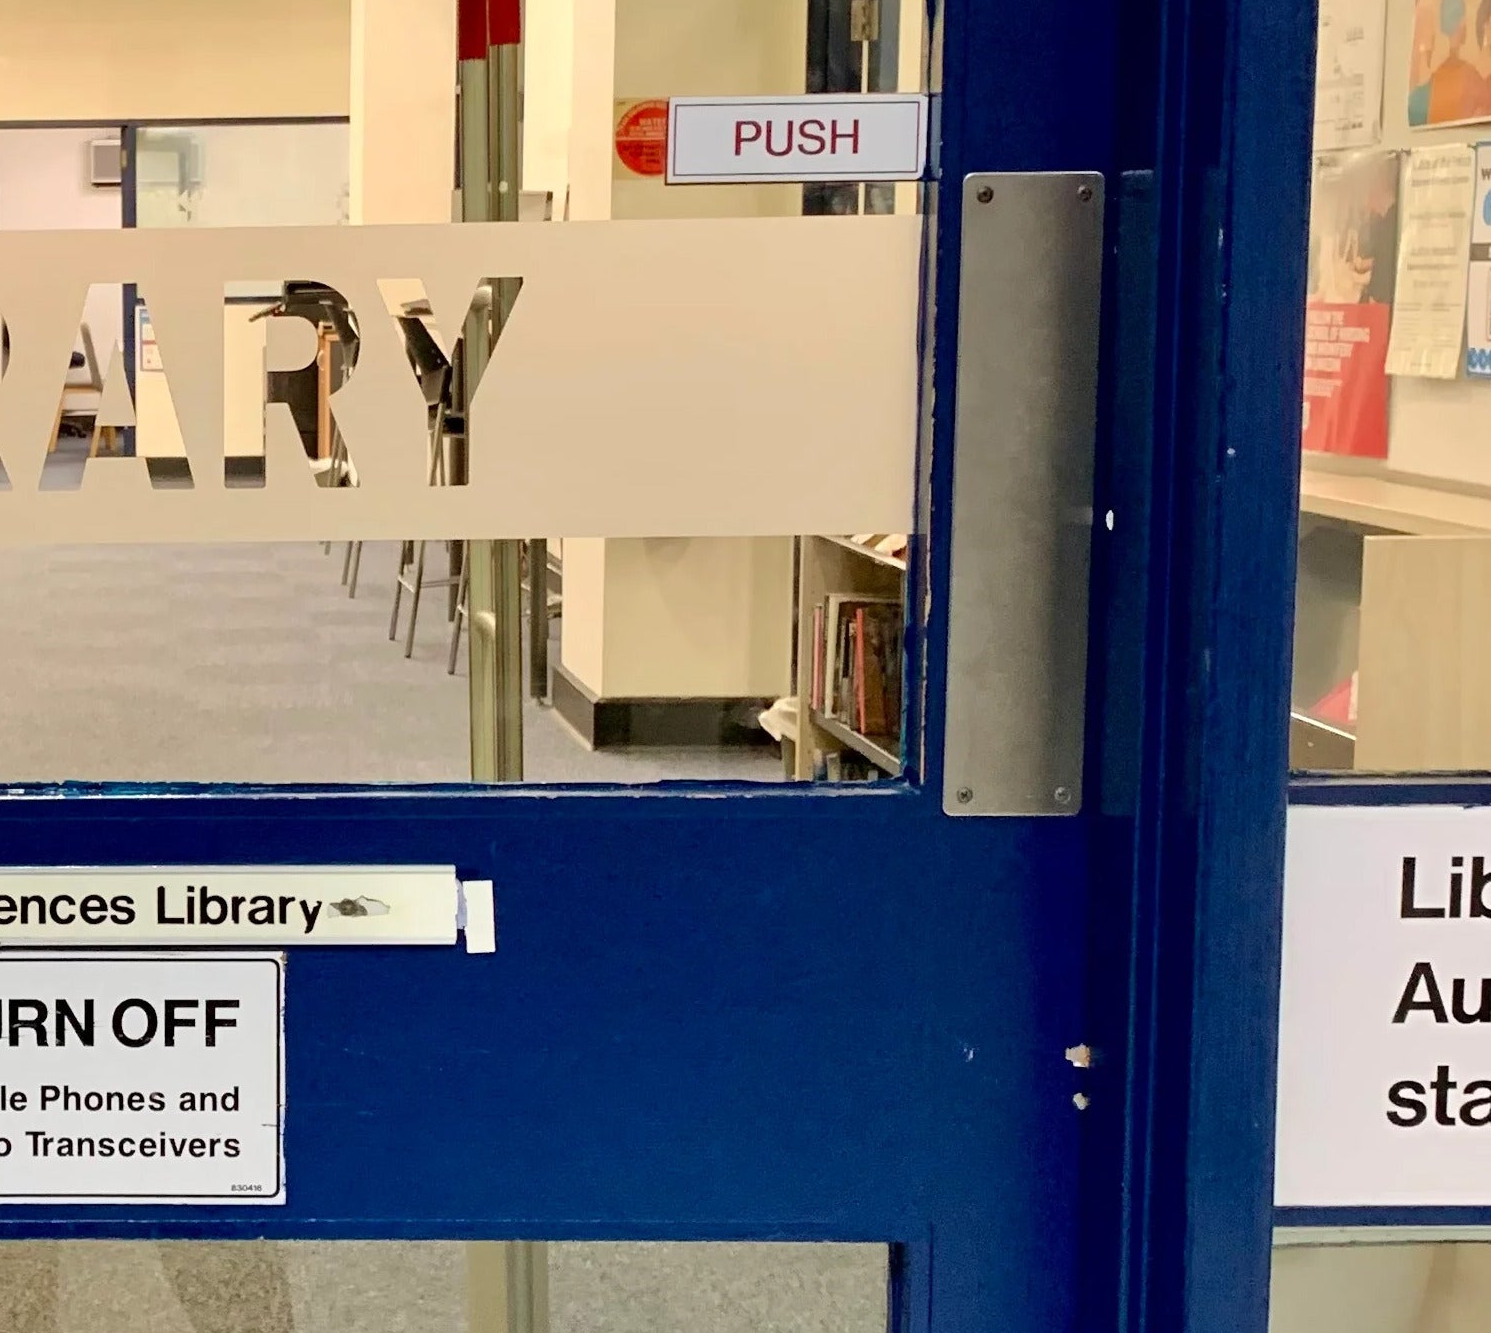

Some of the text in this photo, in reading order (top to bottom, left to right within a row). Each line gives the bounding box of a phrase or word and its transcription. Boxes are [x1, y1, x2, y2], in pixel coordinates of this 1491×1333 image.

[734, 119, 860, 157] PUSH
[157, 885, 323, 934] Library
[111, 998, 240, 1048] OFF
[40, 1085, 166, 1112] Phones
[179, 1085, 239, 1112] and
[25, 1131, 241, 1158] Transceivers
